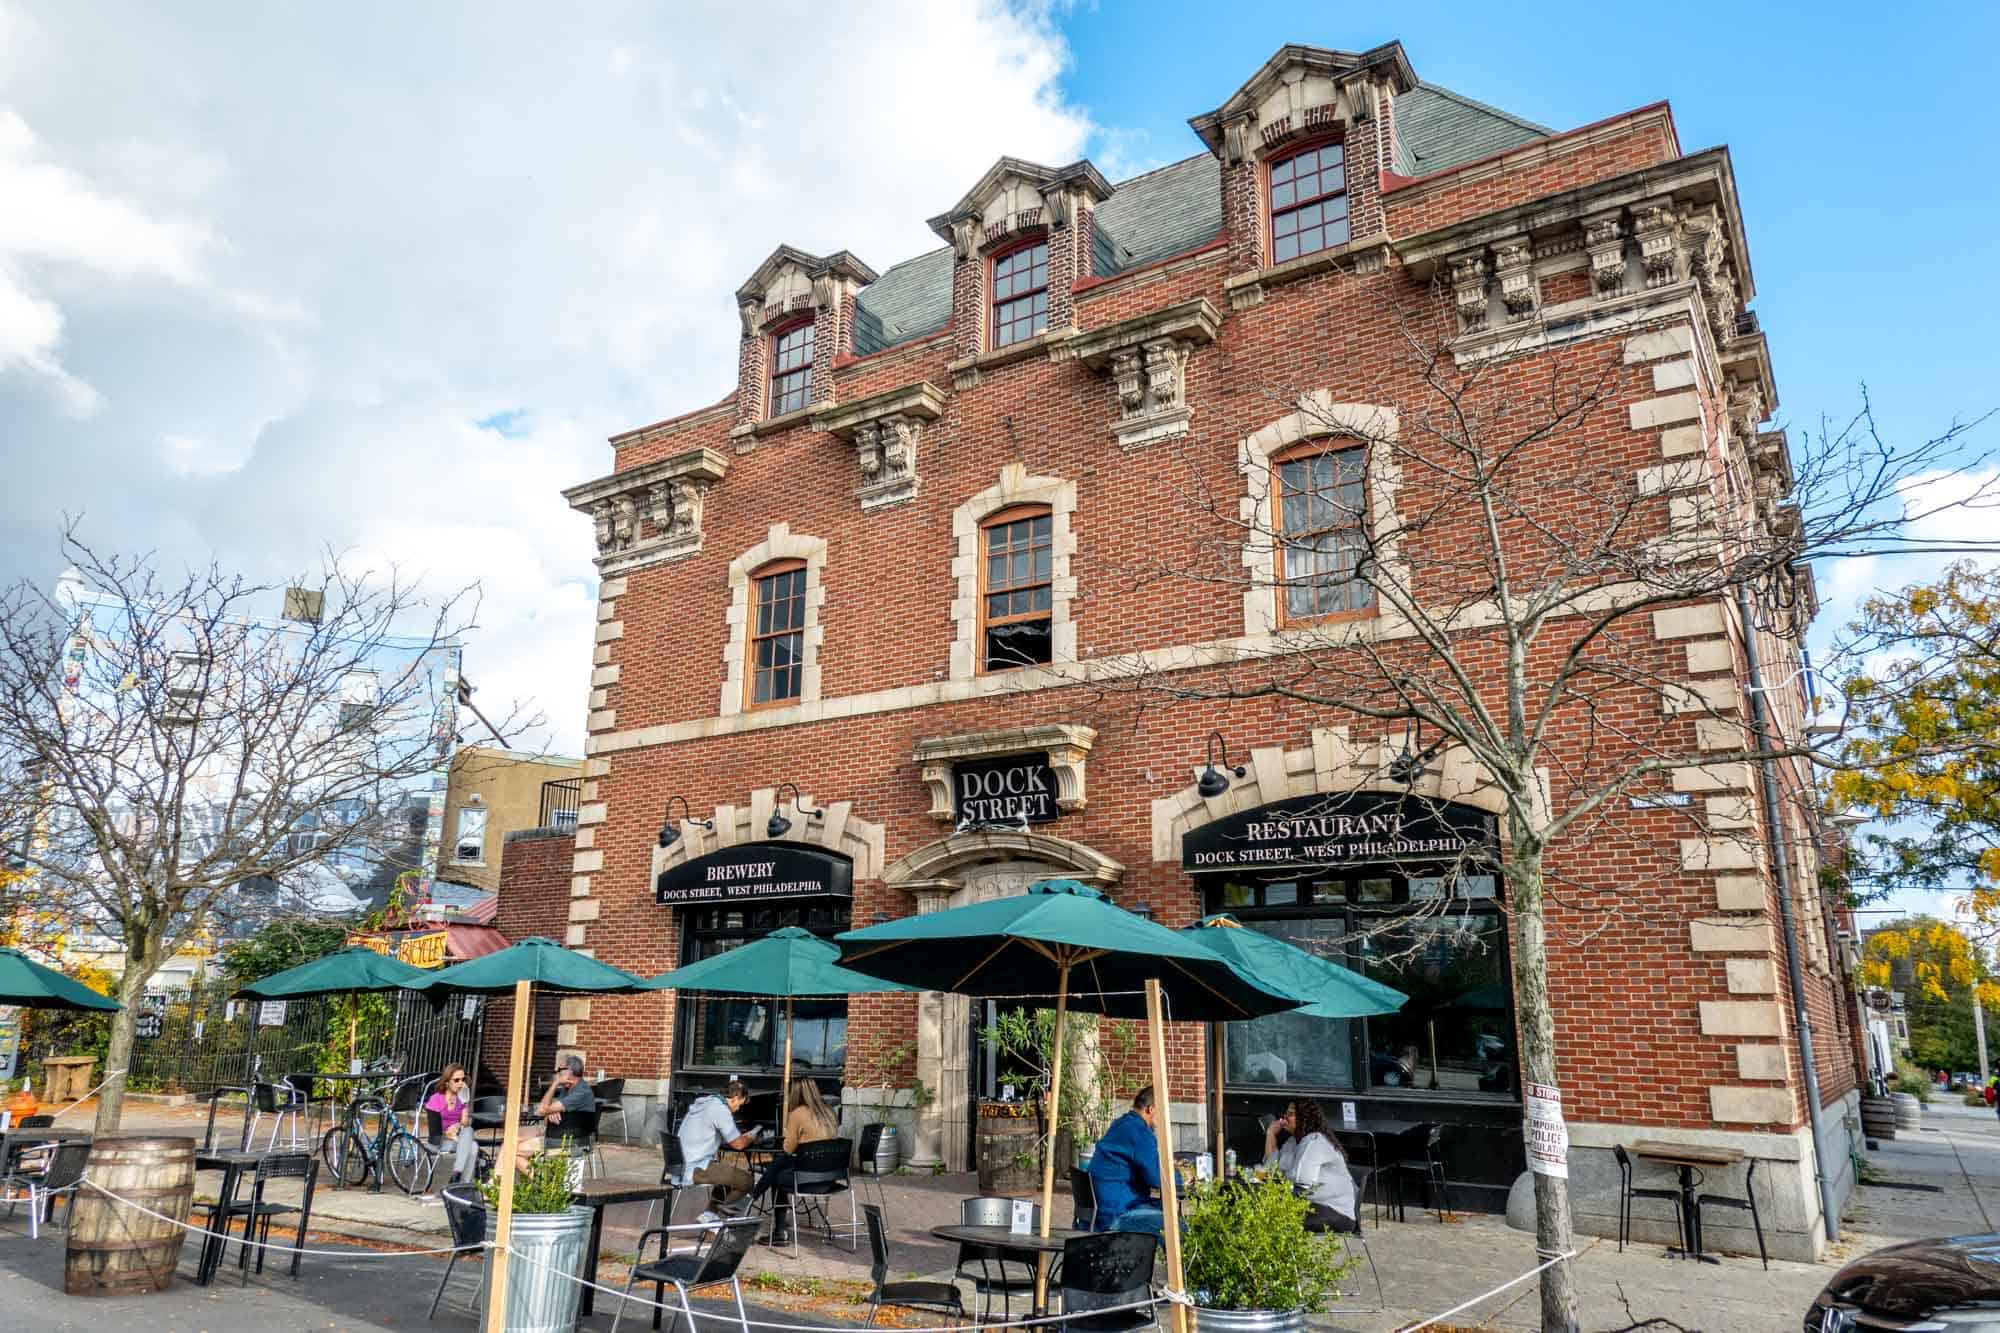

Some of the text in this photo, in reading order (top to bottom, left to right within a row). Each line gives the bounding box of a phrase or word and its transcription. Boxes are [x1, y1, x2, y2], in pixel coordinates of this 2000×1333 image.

[961, 765, 1048, 799] DOCK
[963, 793, 1050, 821] STREET
[1246, 813, 1407, 841] RESTAURANT
[1195, 849, 1235, 865] DOCK
[1303, 844, 1345, 858] WEST
[707, 861, 776, 881] BREWERY
[663, 880, 823, 901] DOCK STREET, WEST PHILADELPHIA
